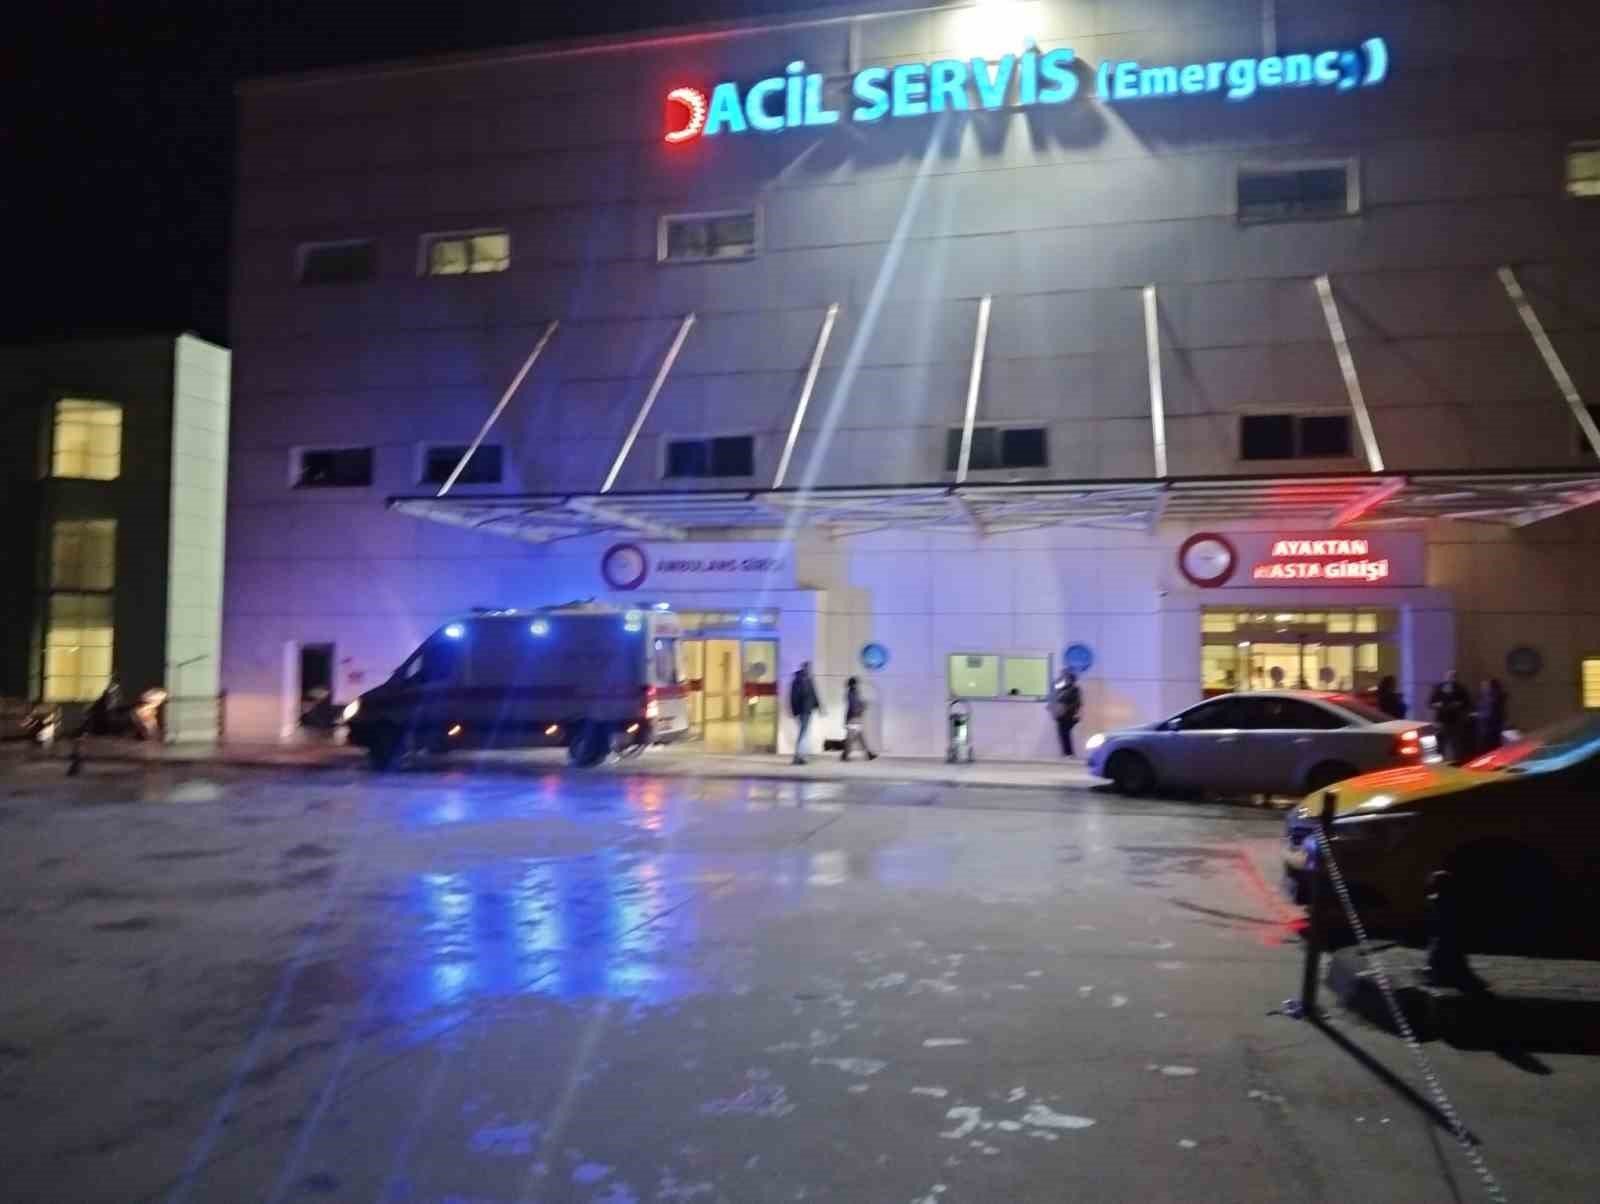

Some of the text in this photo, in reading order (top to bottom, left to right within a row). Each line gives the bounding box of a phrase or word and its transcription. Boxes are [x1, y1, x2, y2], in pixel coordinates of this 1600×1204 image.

[704, 61, 839, 135] ACİL
[853, 39, 1077, 121] SERVİS
[1271, 540, 1369, 556] AYAKTAN
[1322, 559, 1389, 581] GİRİŞİ
